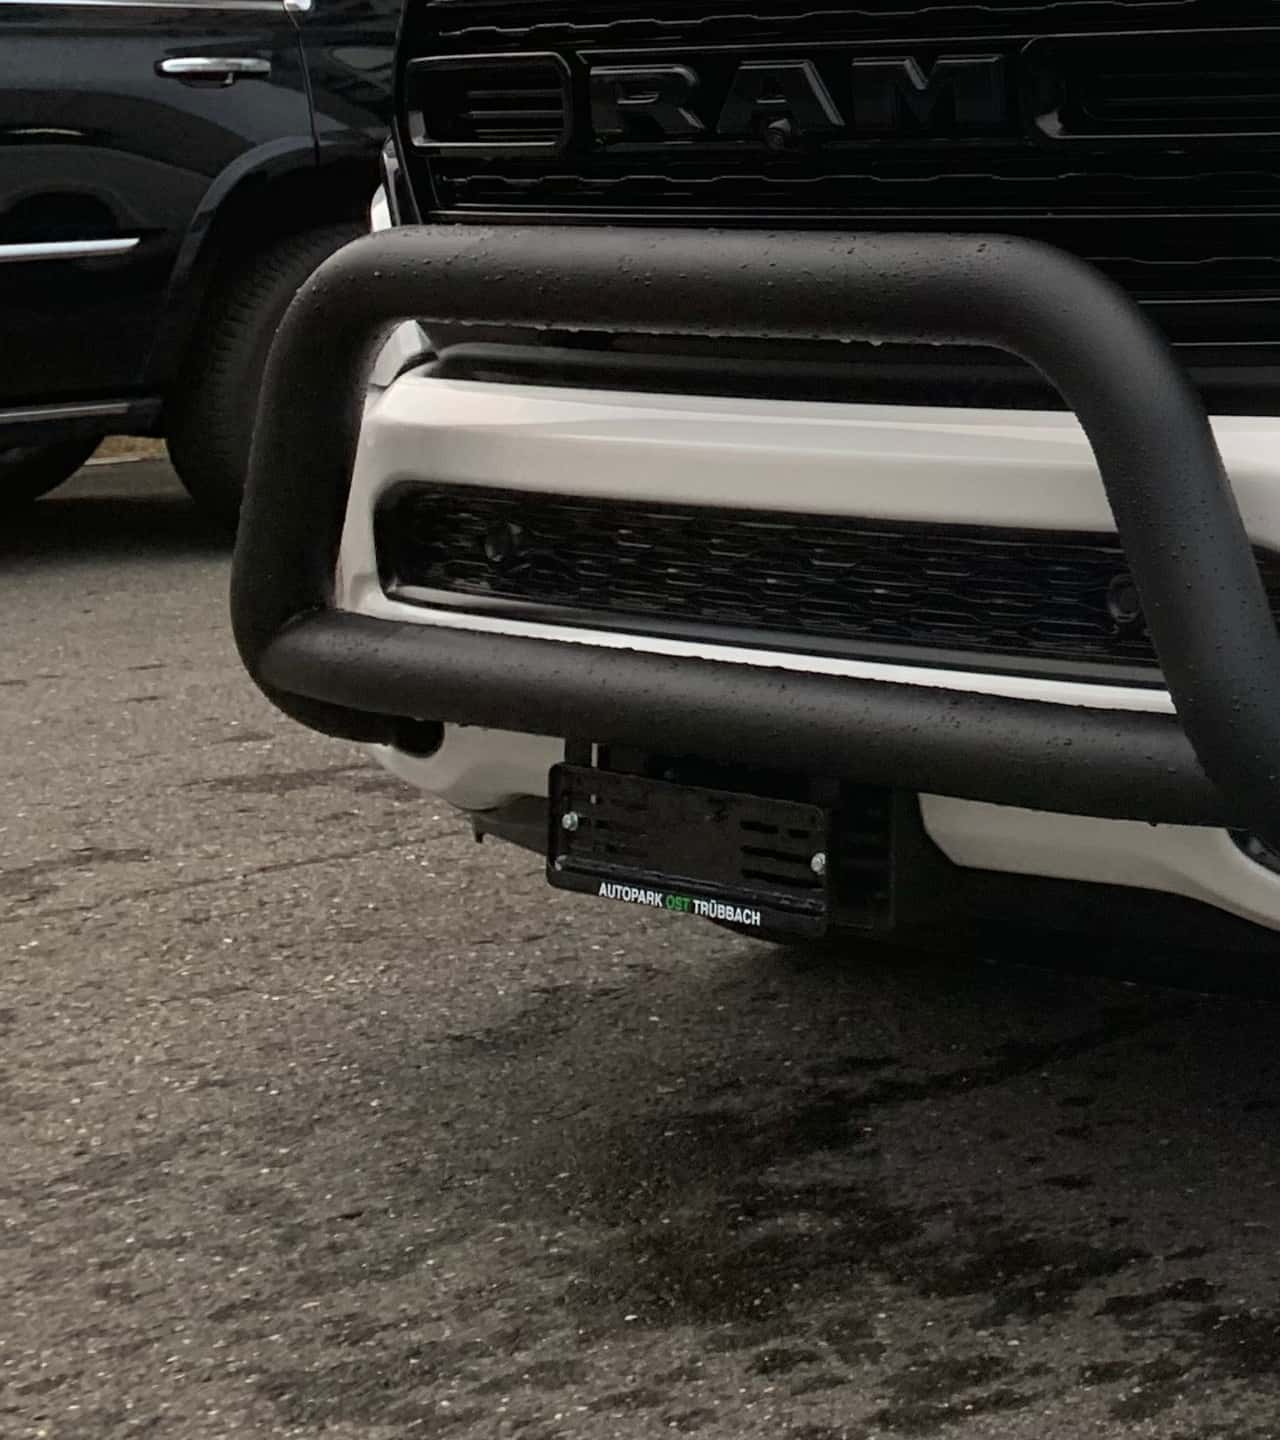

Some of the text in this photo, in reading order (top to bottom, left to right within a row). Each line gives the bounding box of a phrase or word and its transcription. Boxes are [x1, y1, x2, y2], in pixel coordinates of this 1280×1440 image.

[589, 55, 1003, 137] RAM
[599, 882, 761, 926] AUTOPARK OST TRÜBBACH
